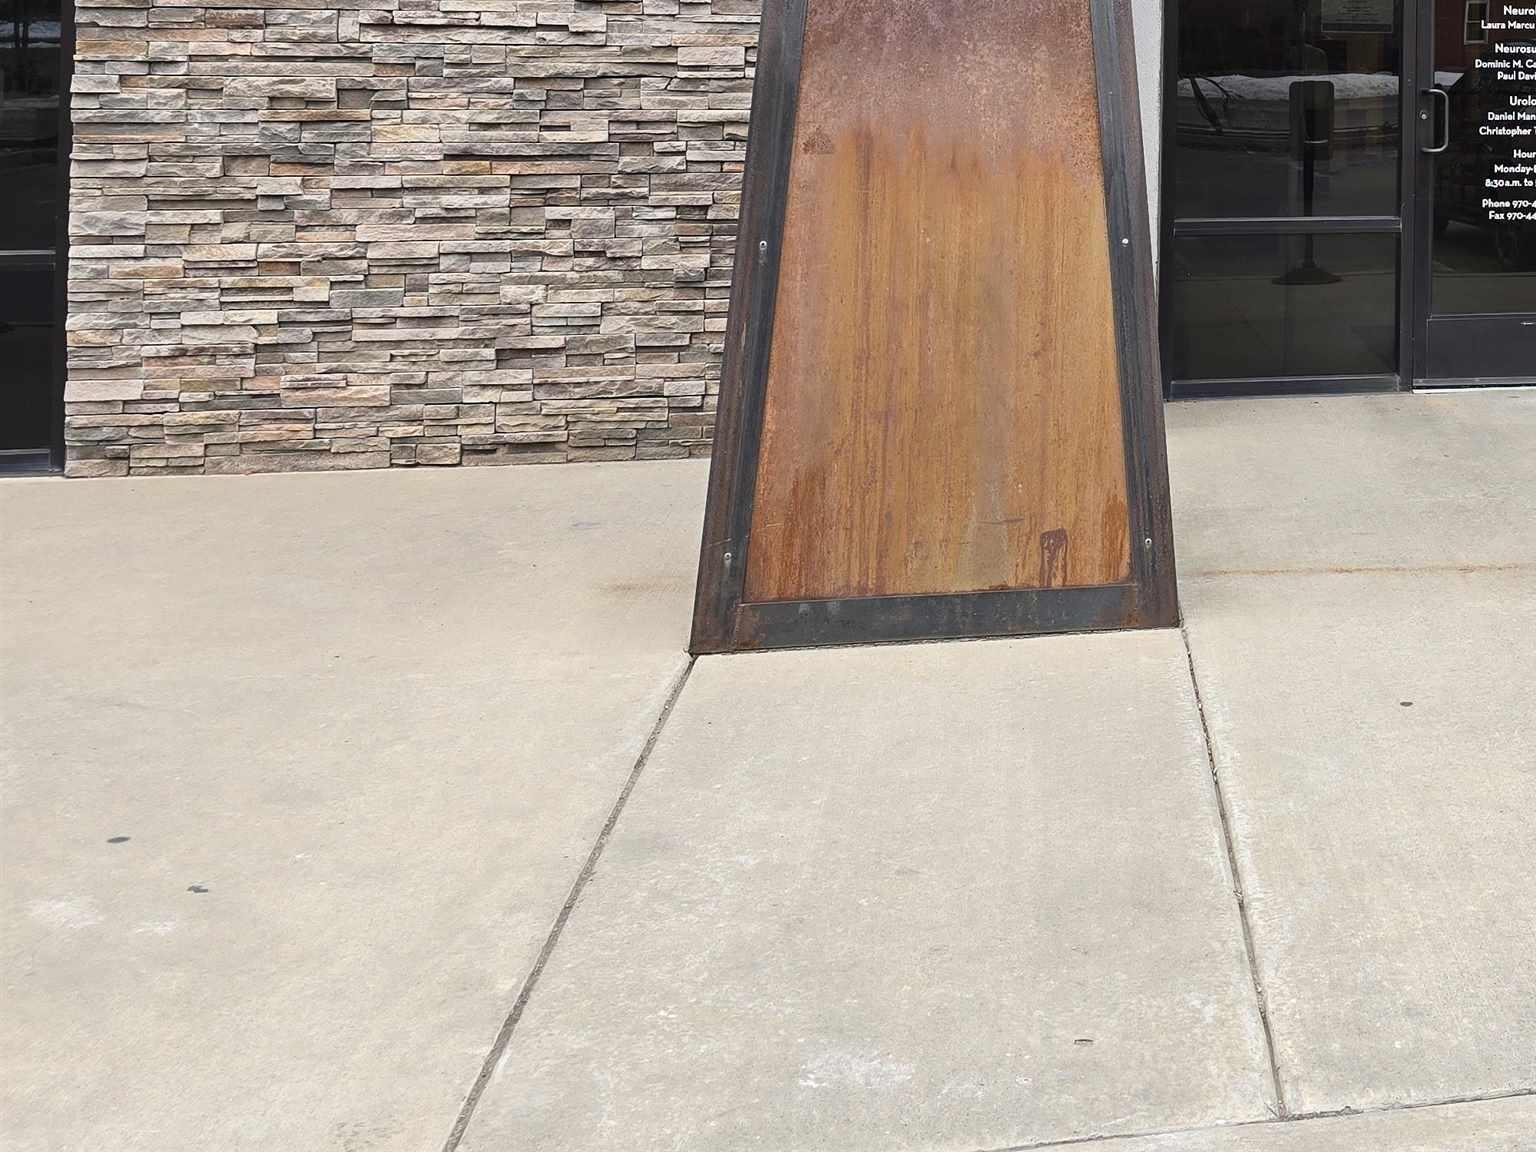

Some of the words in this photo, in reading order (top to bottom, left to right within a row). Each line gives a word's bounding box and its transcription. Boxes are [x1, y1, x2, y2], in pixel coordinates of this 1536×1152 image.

[1481, 20, 1506, 30] Laura
[1507, 20, 1535, 30] Marcu
[1475, 59, 1511, 69] Dominic
[1512, 59, 1524, 69] M.
[1497, 71, 1516, 81] Paul
[1487, 111, 1516, 121] Daniel
[1478, 125, 1532, 137] Christopher
[1523, 177, 1533, 187] to
[1482, 198, 1511, 208] Phone
[1488, 211, 1505, 220] Fax
